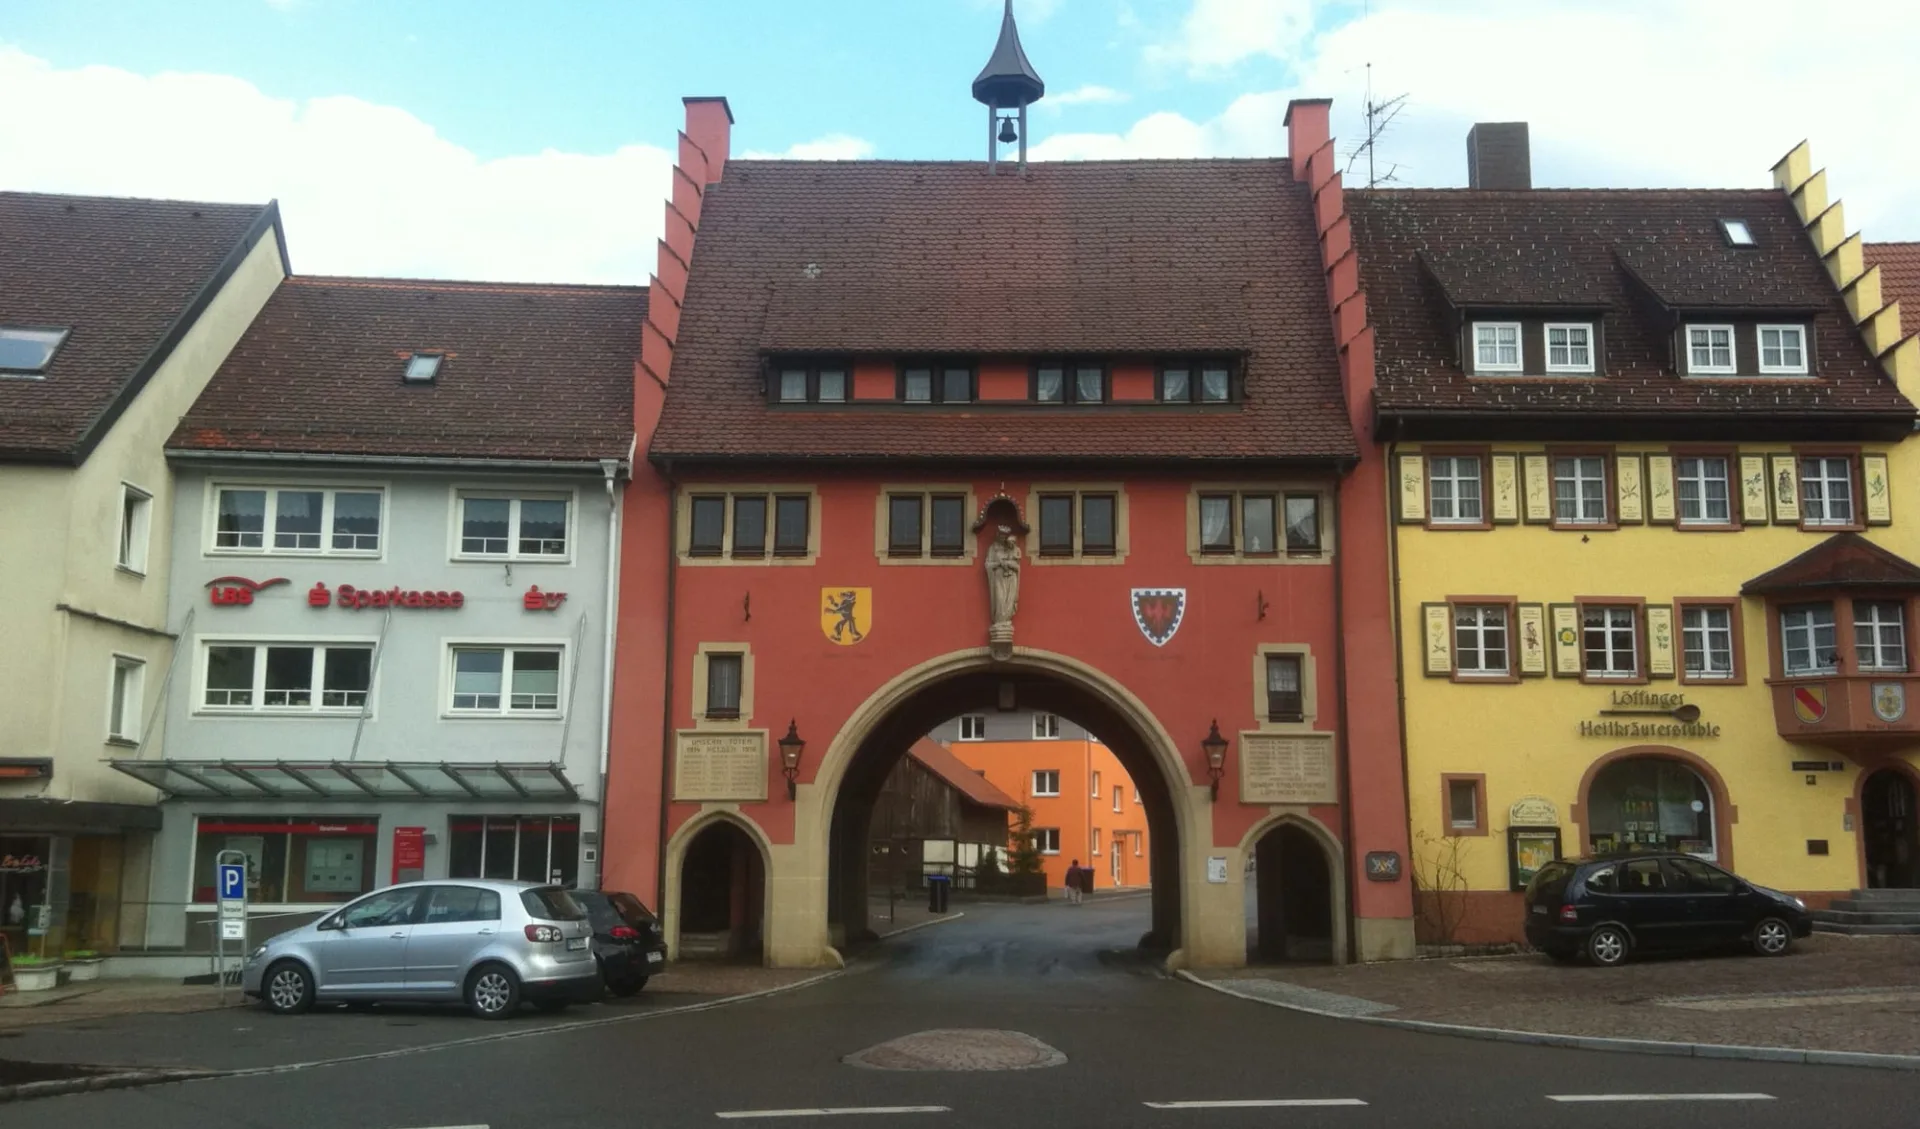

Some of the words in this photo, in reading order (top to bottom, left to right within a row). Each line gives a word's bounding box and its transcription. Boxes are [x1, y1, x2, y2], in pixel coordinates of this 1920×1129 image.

[211, 586, 254, 606] LBS
[337, 584, 465, 610] Sparkasse
[1611, 690, 1685, 708] Löffinger
[226, 869, 240, 895] P
